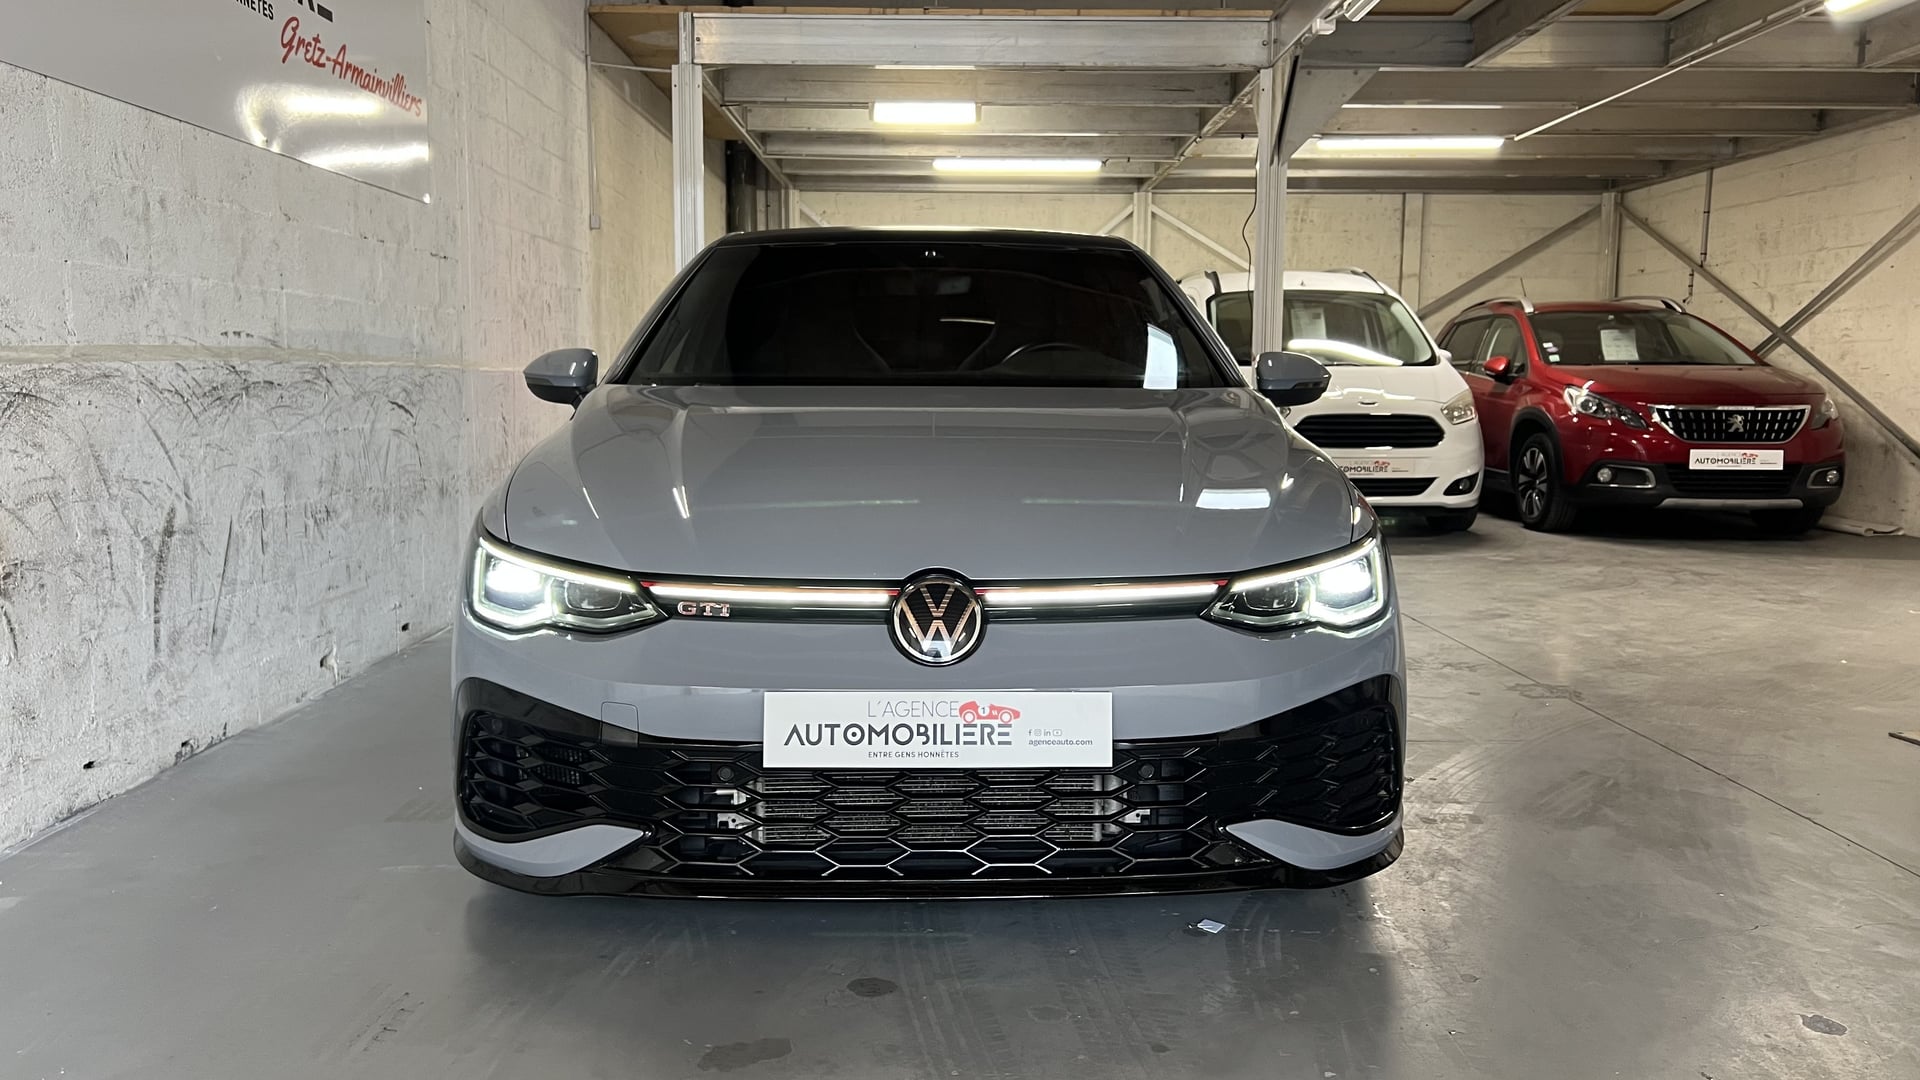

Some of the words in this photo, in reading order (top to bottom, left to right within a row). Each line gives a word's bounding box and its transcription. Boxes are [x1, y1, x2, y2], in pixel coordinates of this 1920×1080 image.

[281, 16, 422, 117] Gretz-Armainvilliers
[677, 601, 730, 617] GTI
[1028, 738, 1093, 746] agenceauto.com
[868, 751, 893, 759] ENTRE
[895, 751, 916, 759] GENS
